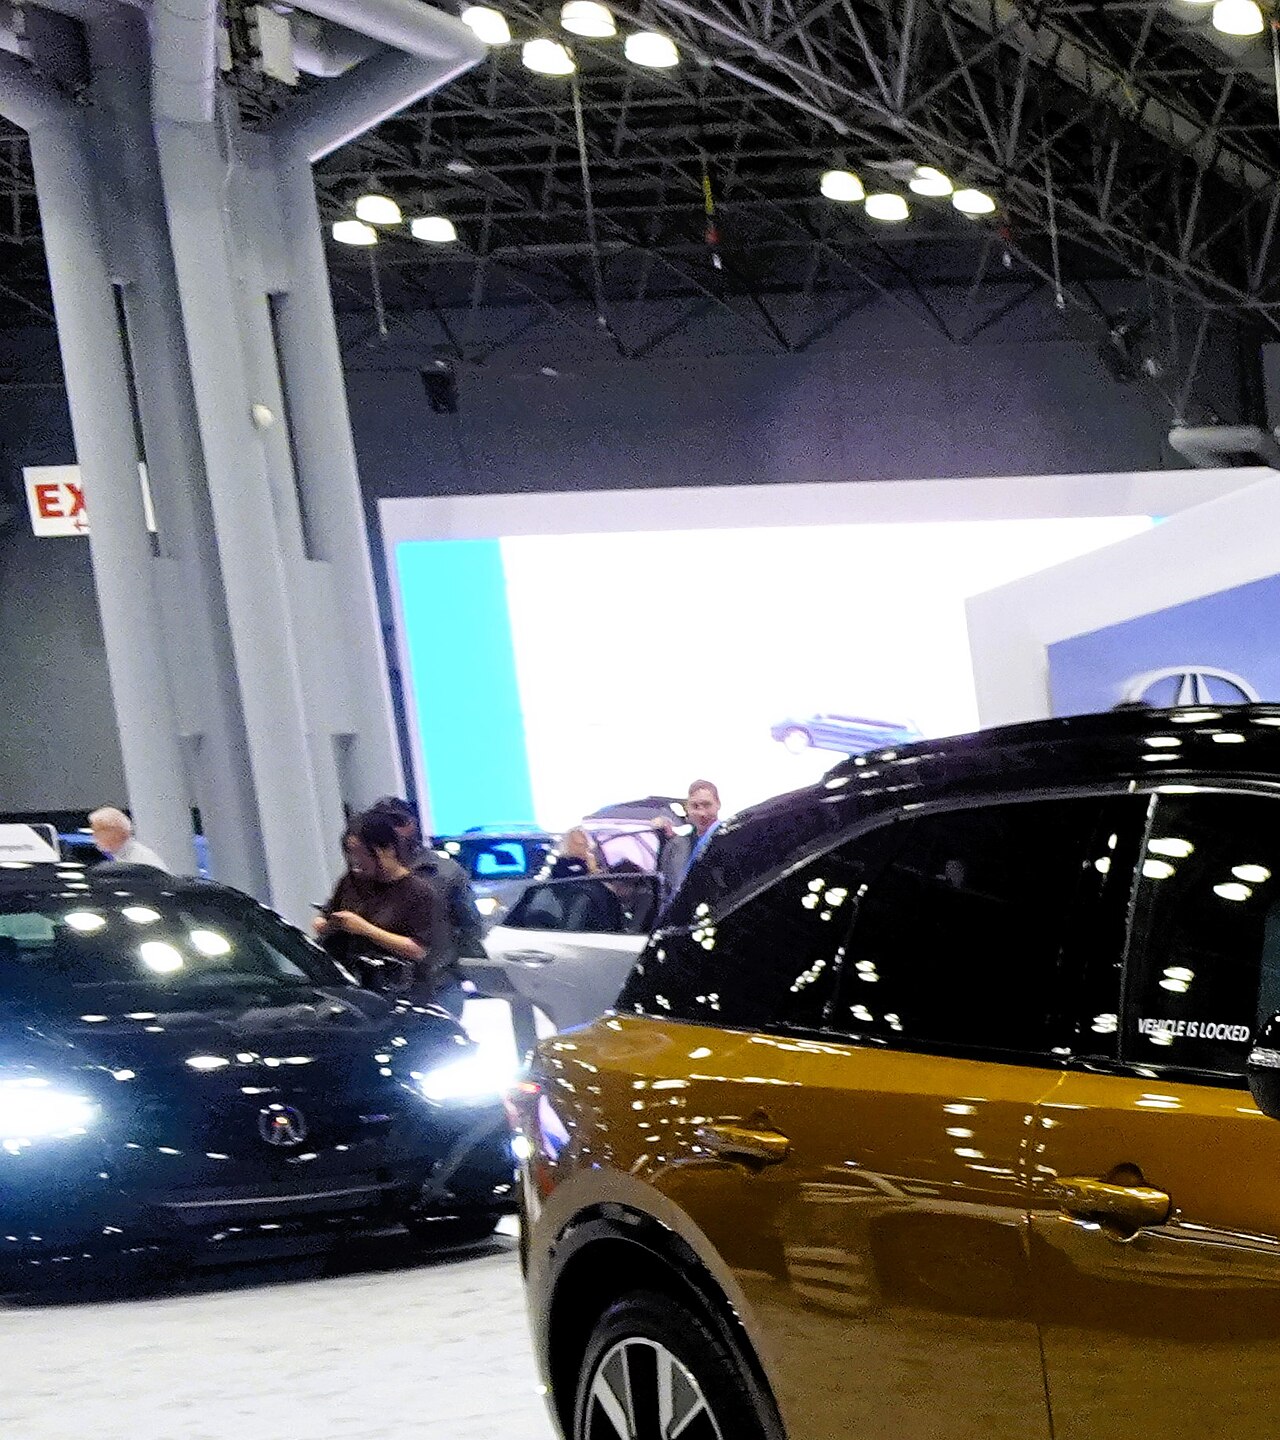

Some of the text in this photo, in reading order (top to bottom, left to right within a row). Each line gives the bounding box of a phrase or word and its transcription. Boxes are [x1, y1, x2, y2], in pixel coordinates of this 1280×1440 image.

[34, 483, 86, 518] EX
[1138, 1018, 1250, 1042] VEHICLE IS LOCKED
